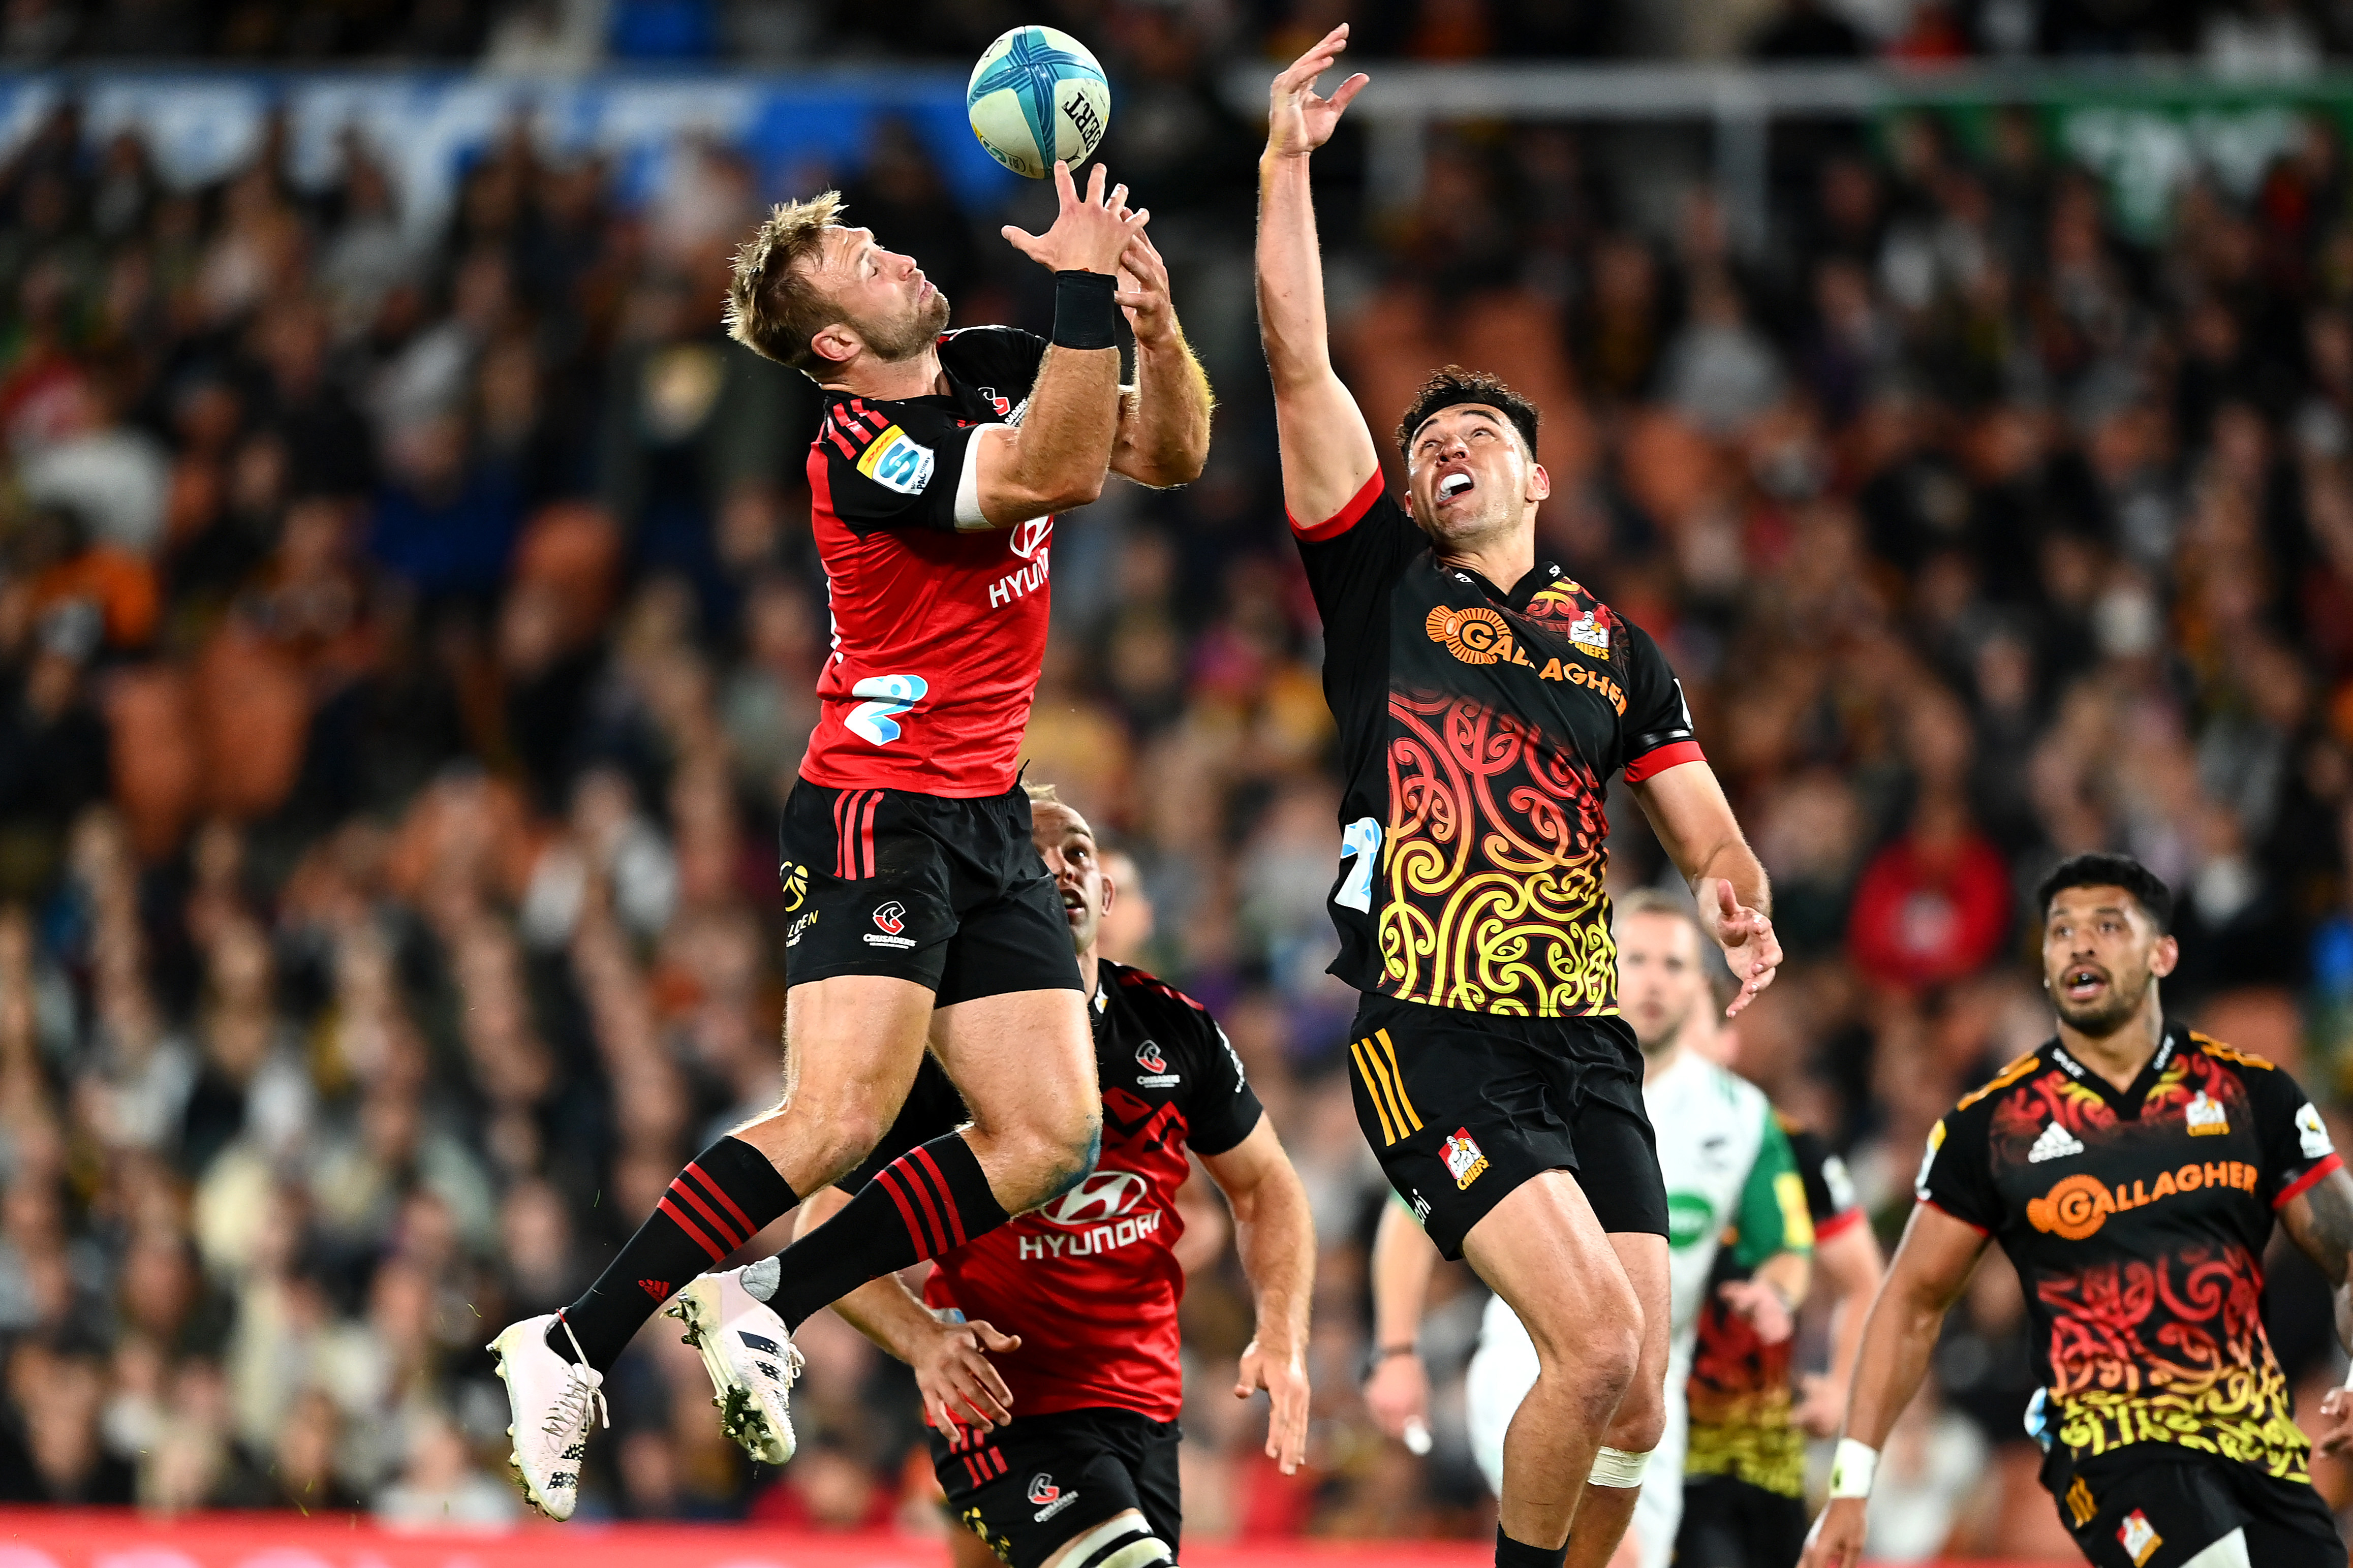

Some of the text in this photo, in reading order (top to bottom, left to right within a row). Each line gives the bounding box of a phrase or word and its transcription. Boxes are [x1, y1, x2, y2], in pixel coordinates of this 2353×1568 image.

[1457, 1155, 1490, 1190] CHIEFS
[2061, 1161, 2258, 1225] GALLAGHER
[1019, 1209, 1162, 1260] HYUNDAI
